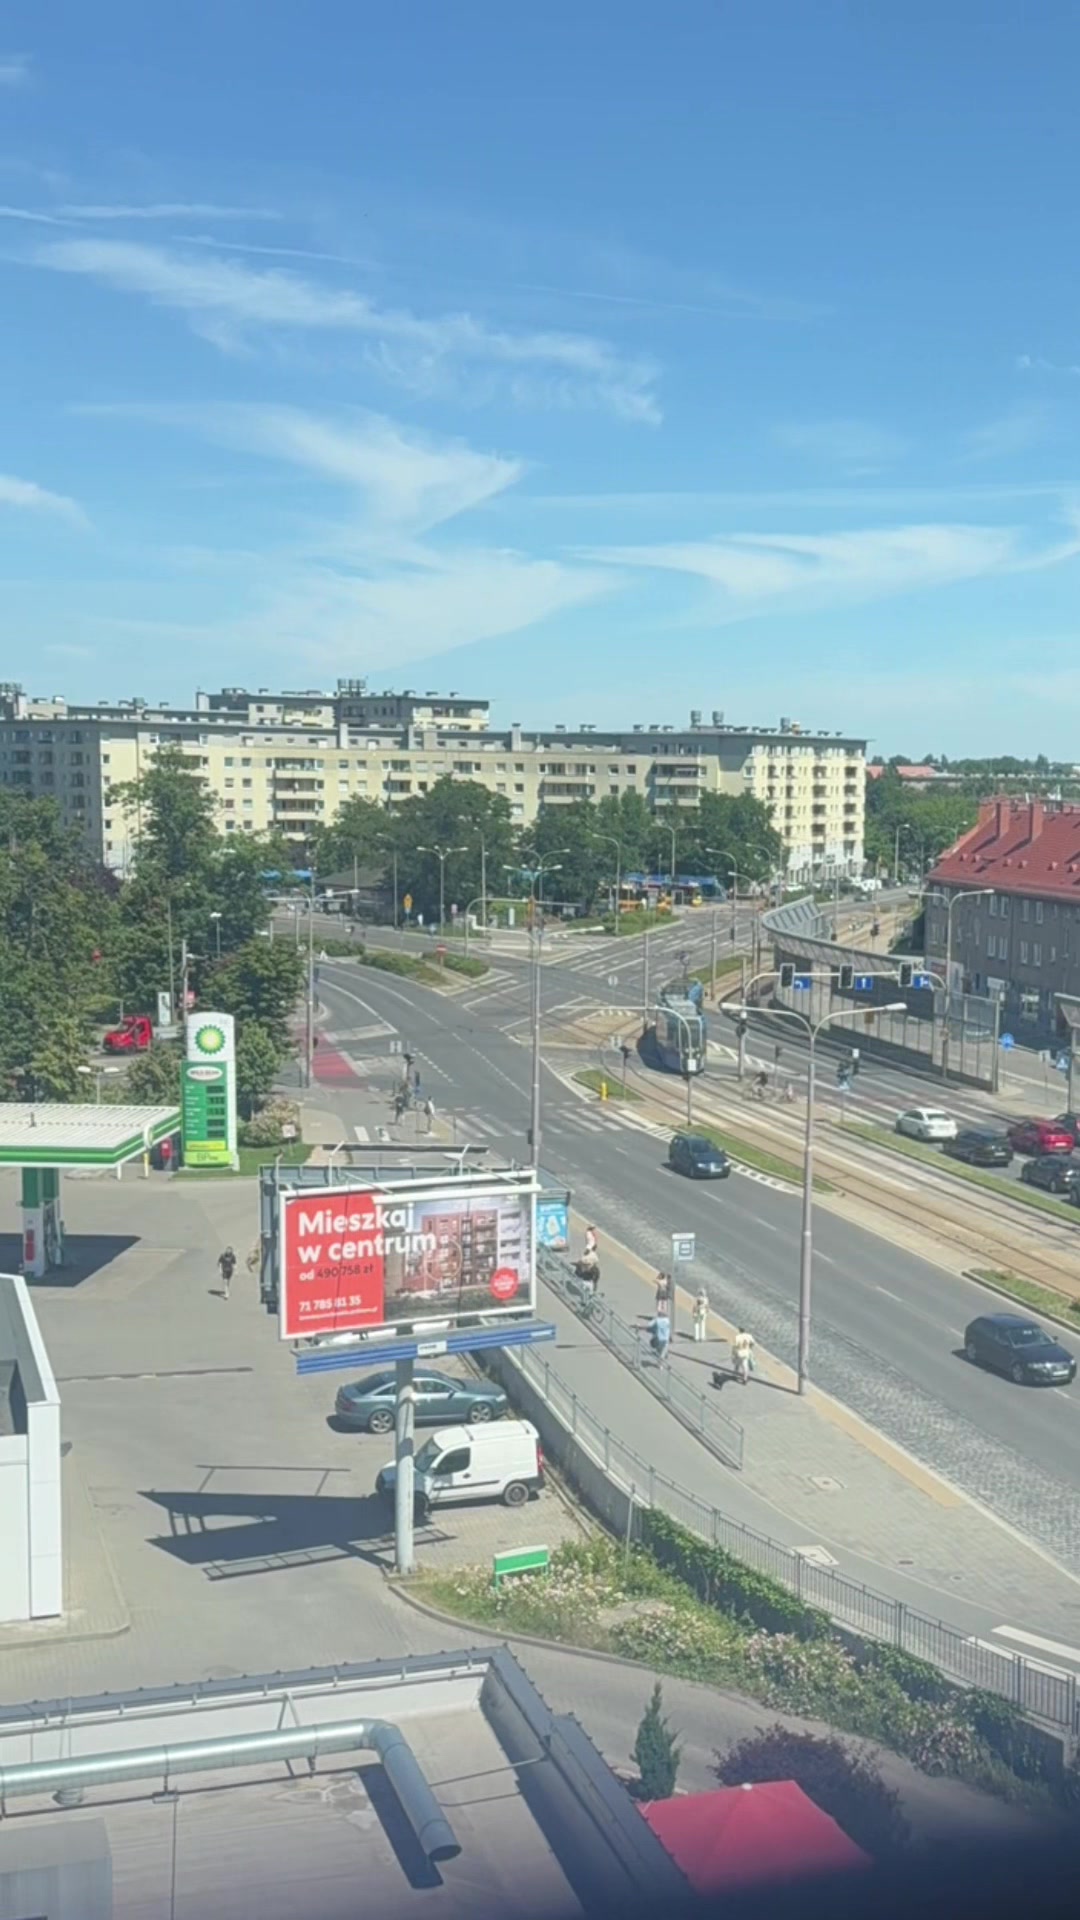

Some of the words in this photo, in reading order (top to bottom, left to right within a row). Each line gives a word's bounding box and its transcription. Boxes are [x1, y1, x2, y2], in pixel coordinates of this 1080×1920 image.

[299, 1202, 414, 1236] Mieszkaj
[297, 1244, 322, 1264] w
[328, 1233, 436, 1261] centrum
[299, 1268, 315, 1282] od
